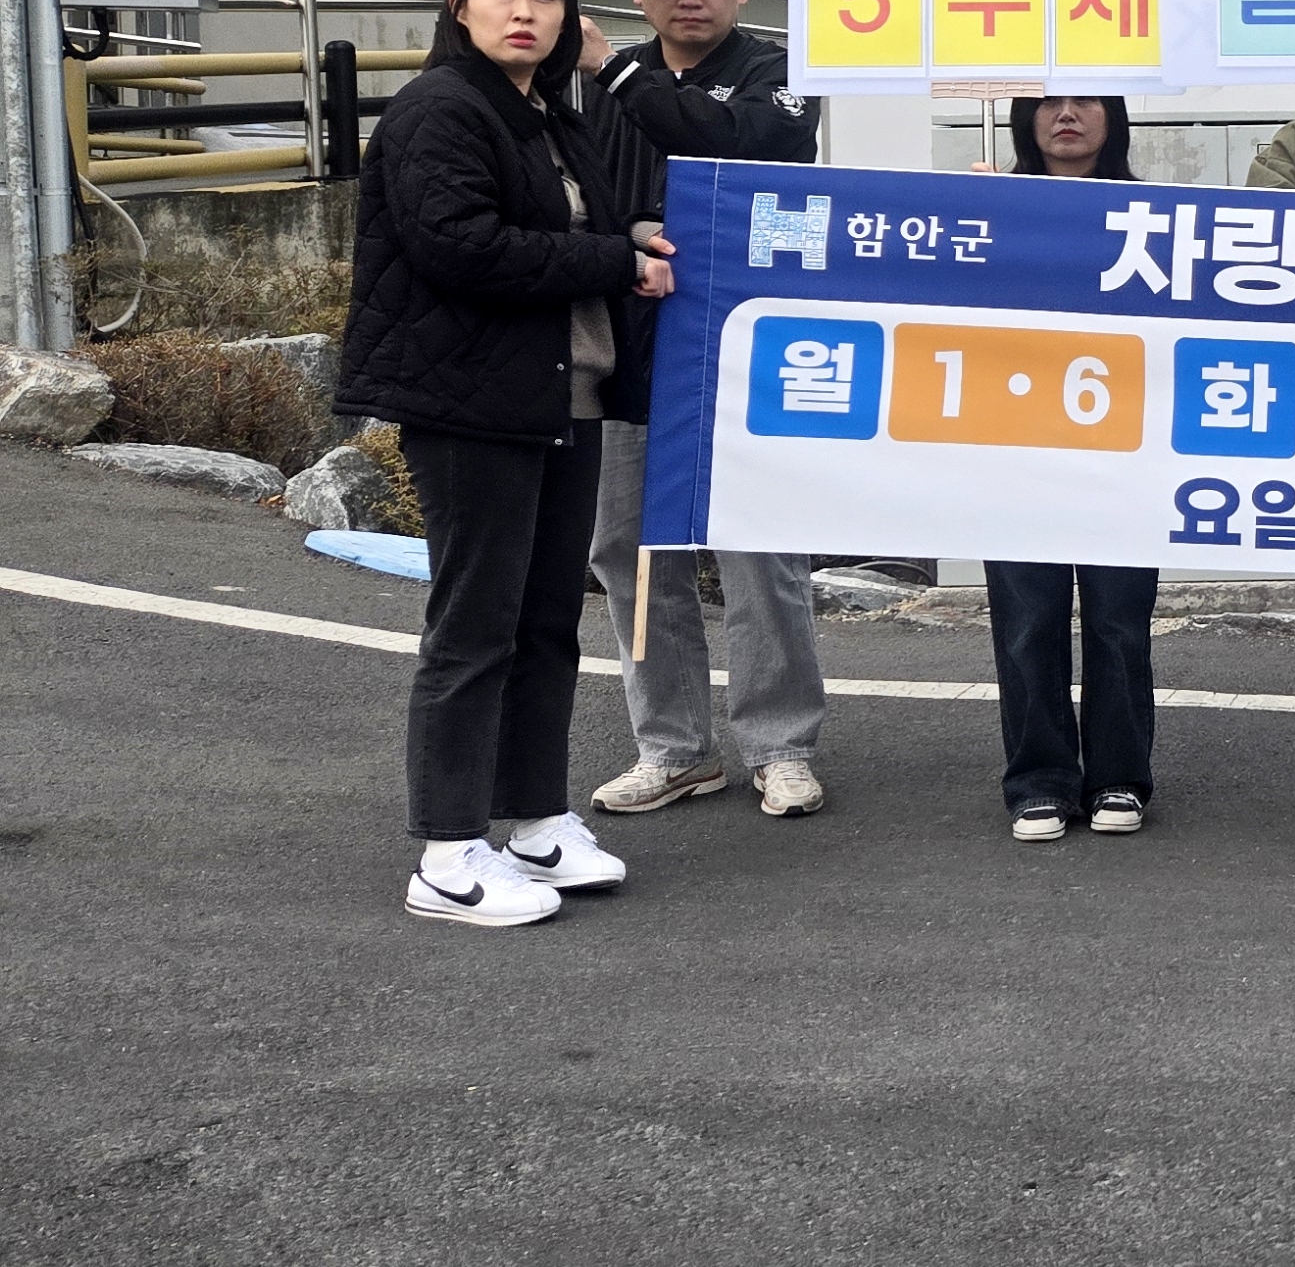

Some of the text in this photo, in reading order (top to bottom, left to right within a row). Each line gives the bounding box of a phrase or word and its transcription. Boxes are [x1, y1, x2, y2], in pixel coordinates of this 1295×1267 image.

[846, 212, 993, 263] 함안군
[778, 339, 856, 415] 월
[1200, 361, 1276, 433] 화
